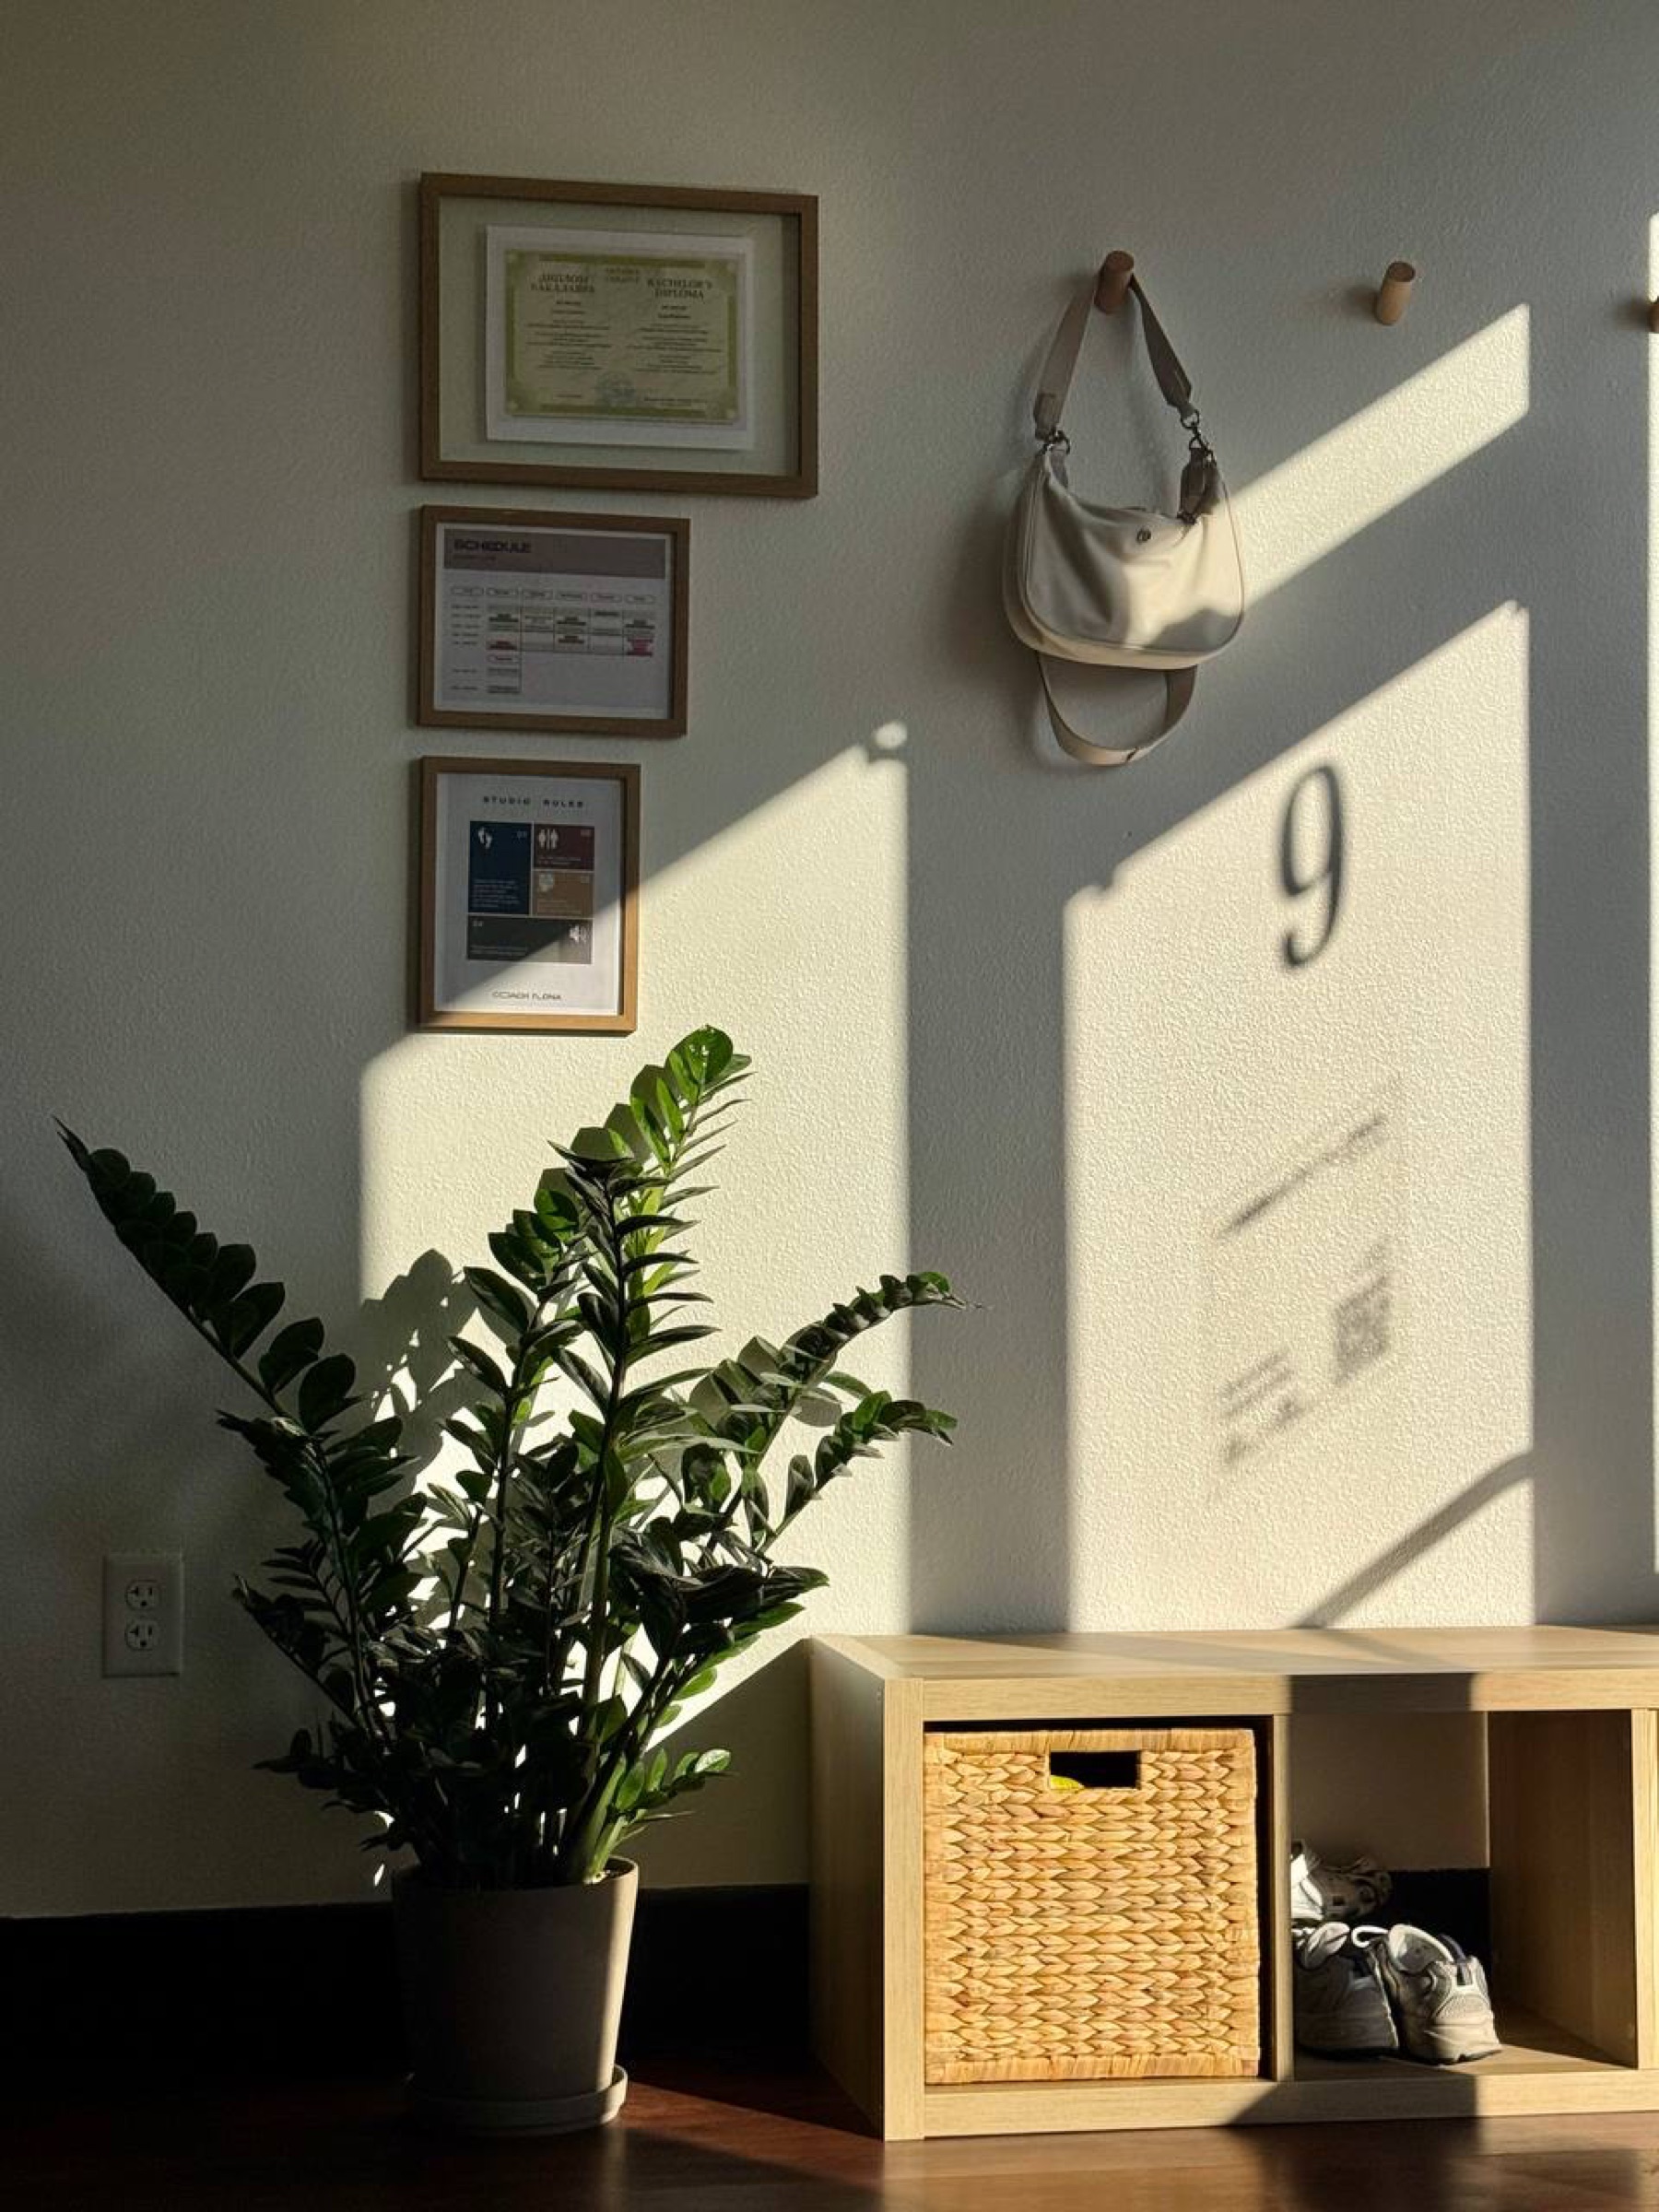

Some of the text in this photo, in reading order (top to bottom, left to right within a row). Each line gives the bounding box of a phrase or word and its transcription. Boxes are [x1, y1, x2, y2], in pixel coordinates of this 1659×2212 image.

[453, 539, 532, 554] SCHEDULE
[483, 795, 584, 808] STUDIO RULES
[1277, 763, 1348, 971] 9
